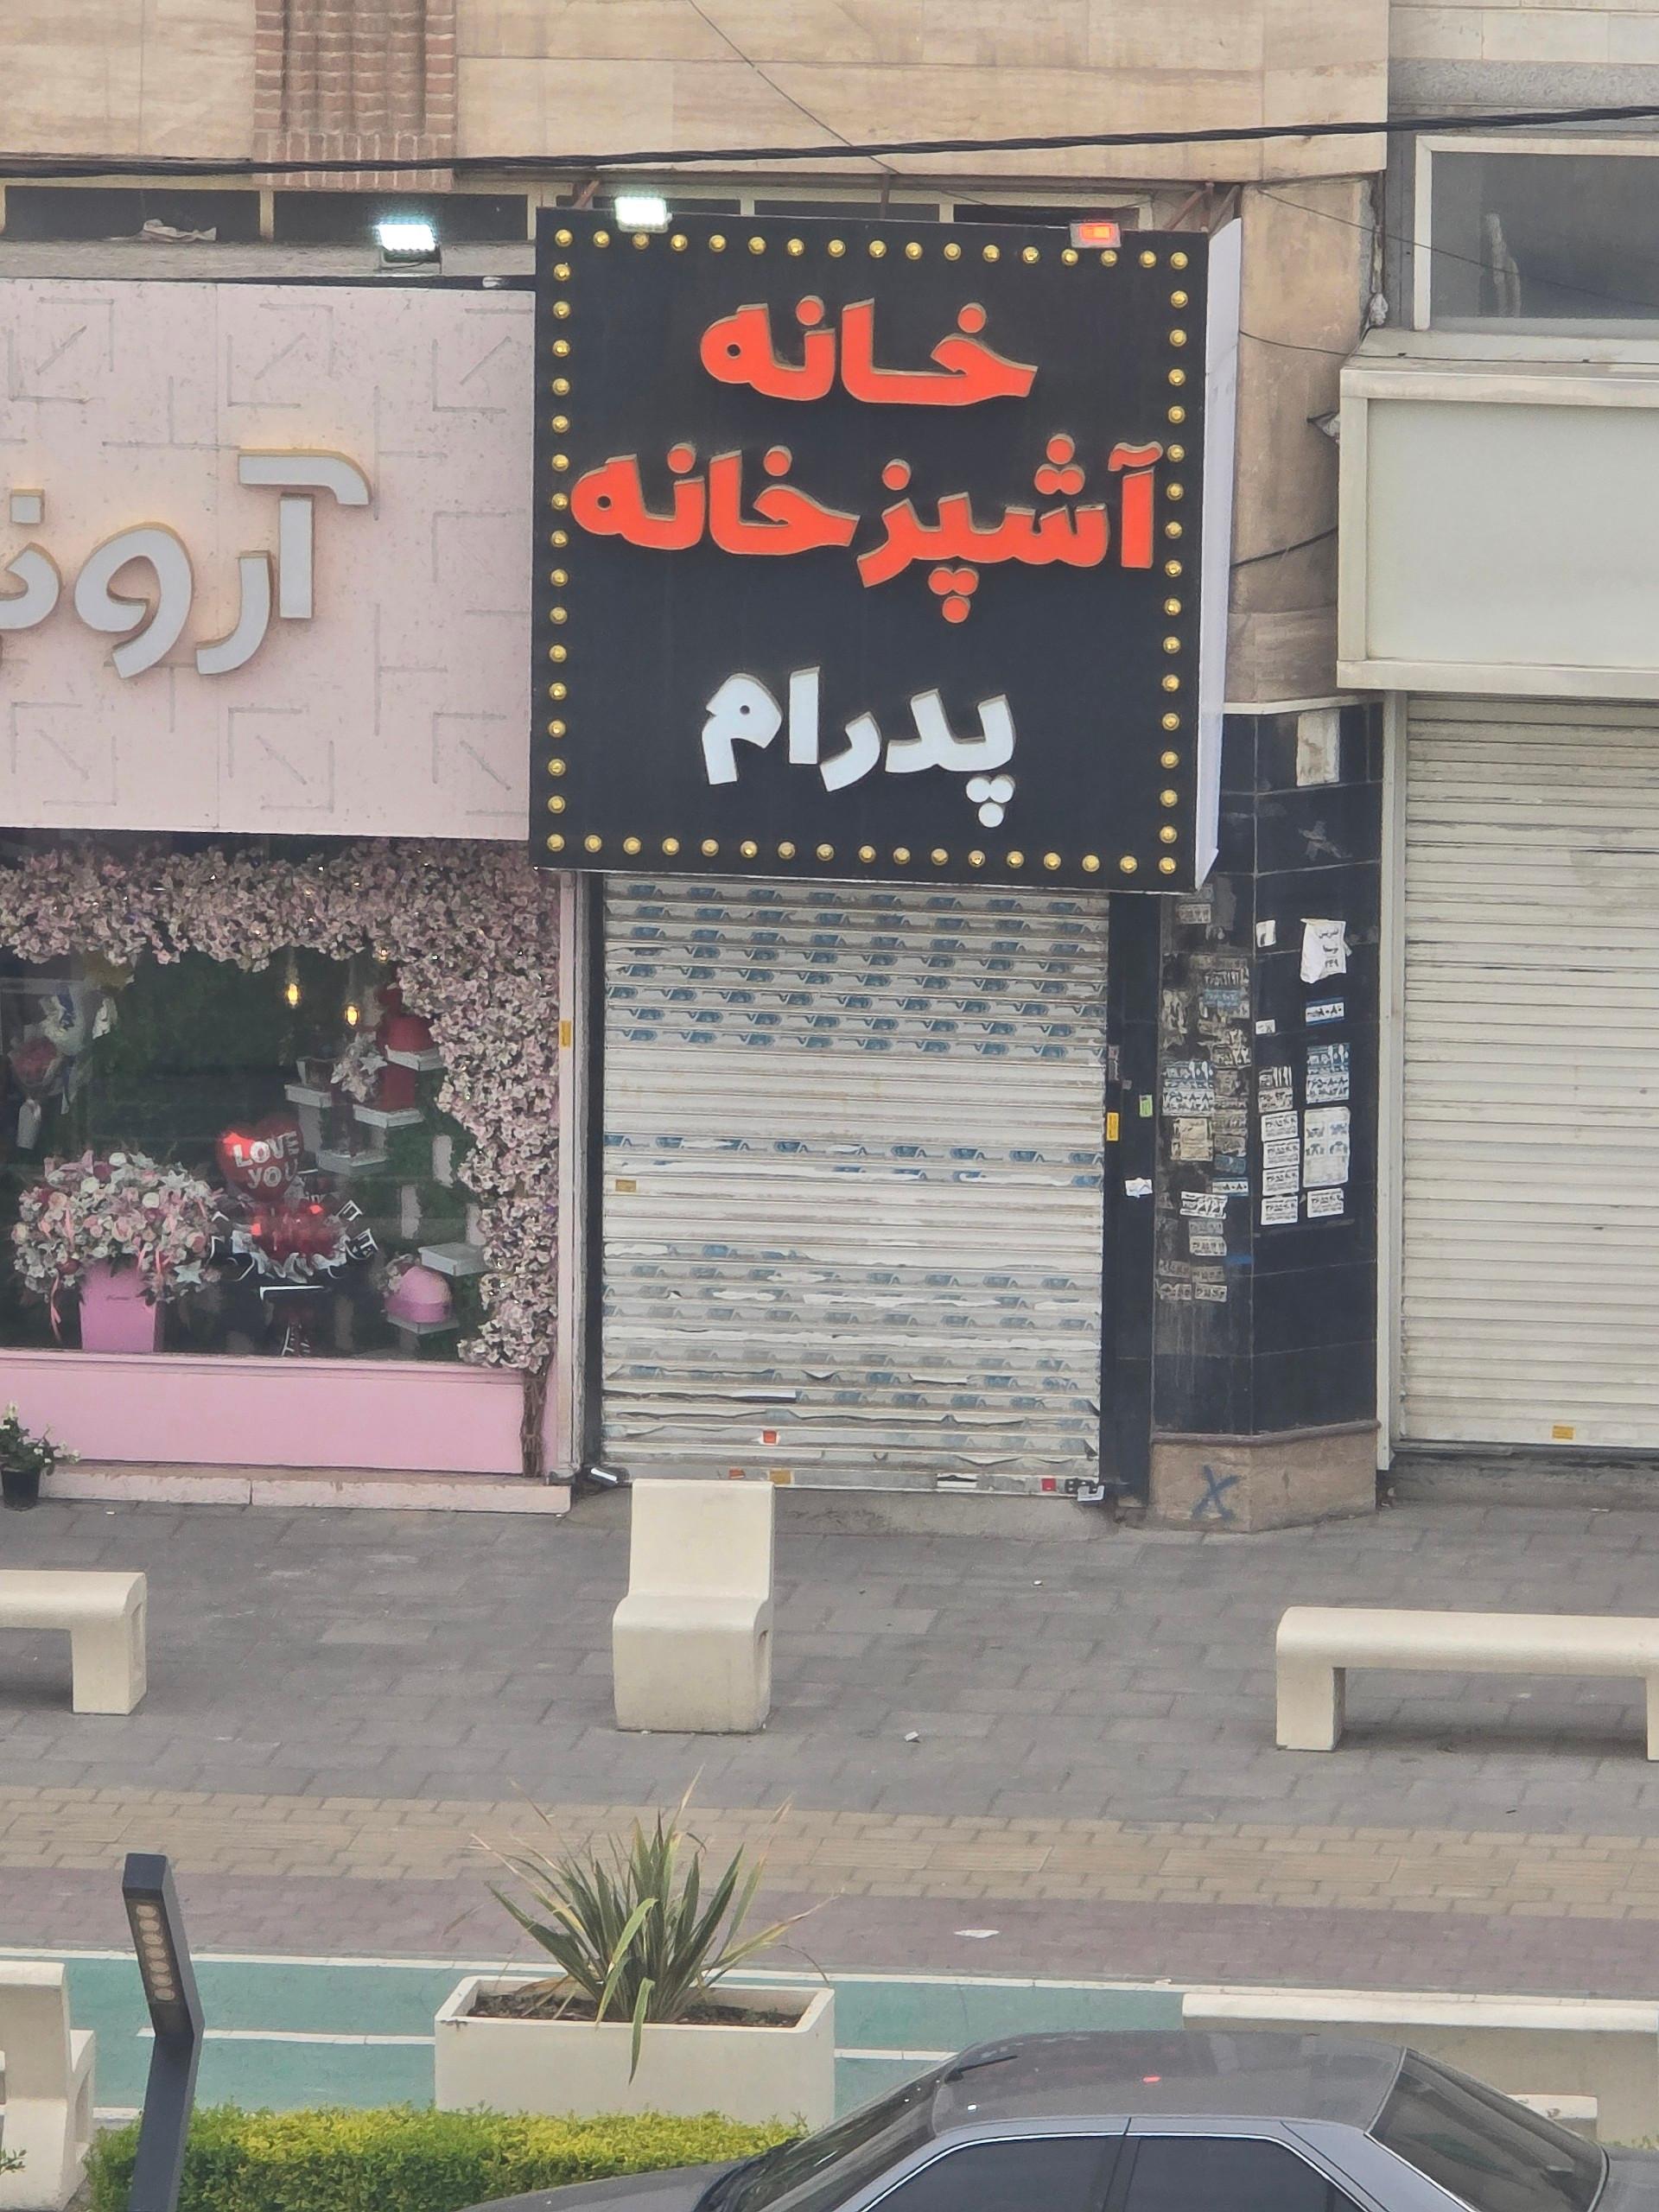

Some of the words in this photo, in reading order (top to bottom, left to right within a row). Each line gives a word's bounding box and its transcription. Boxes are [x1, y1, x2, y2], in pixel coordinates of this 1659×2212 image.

[701, 296, 1037, 406] خانه
[0, 448, 372, 678] آرون
[701, 665, 1016, 828] پدرام
[233, 1131, 300, 1167] LOVE
[247, 1158, 298, 1189] YOU
